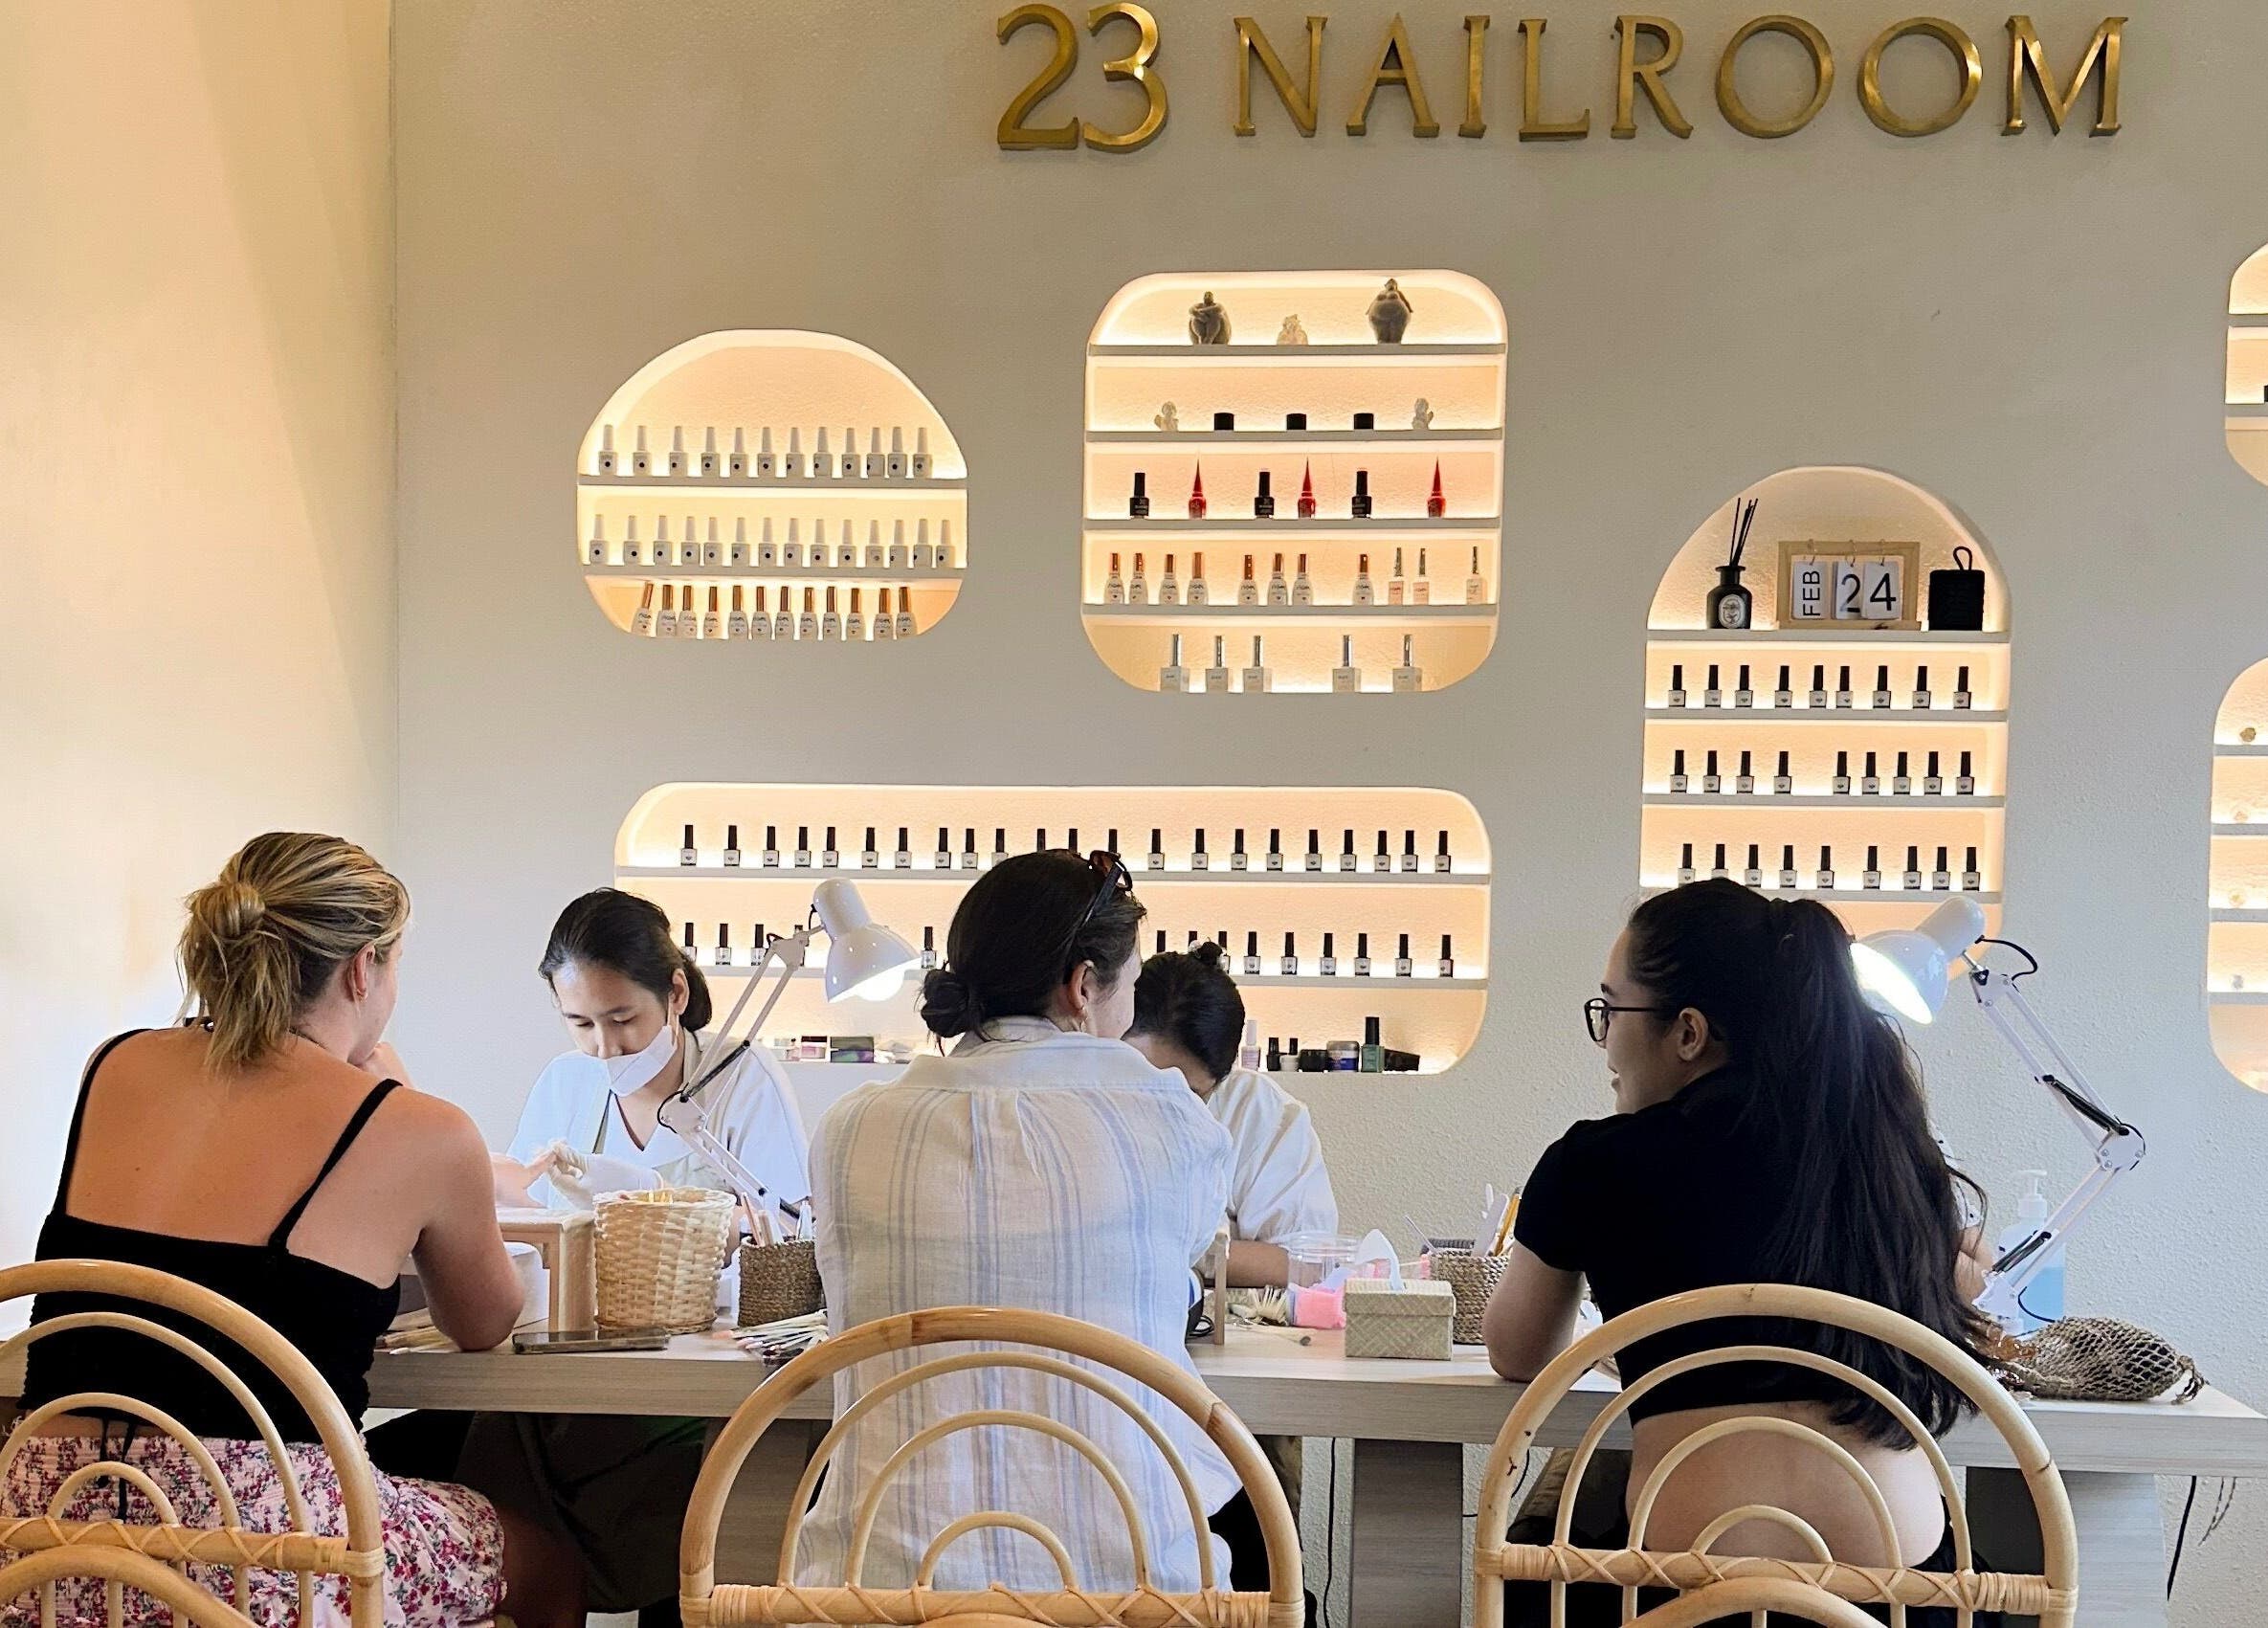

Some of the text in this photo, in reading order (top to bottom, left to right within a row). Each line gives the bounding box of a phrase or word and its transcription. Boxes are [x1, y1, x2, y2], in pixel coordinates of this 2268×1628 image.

[996, 3, 2128, 151] 23 NAILROOM
[1803, 570, 1820, 616] FEB
